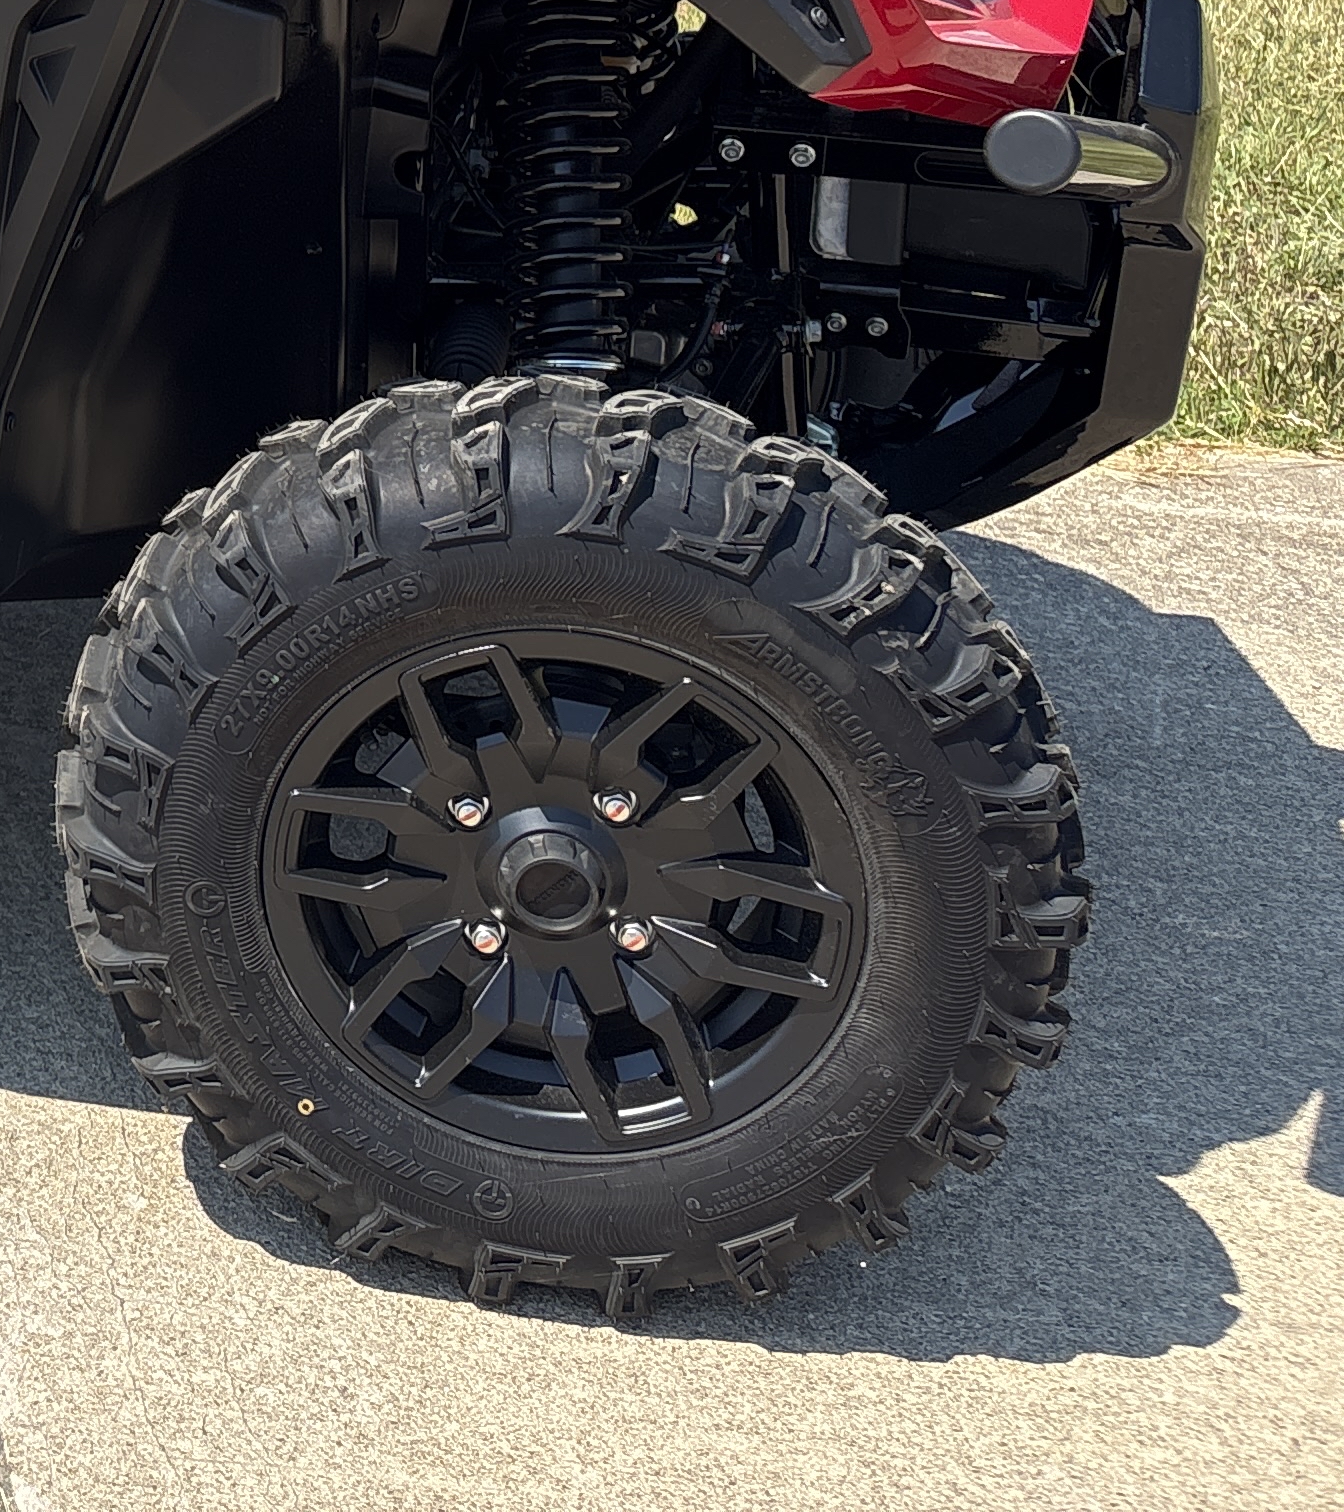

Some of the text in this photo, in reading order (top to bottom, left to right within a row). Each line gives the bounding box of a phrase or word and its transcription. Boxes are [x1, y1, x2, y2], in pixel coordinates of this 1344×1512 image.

[272, 677, 296, 703] FOR
[292, 637, 347, 681] HIGHWAY
[349, 607, 406, 641] SERVICE
[712, 632, 894, 772] ARMSTRONG
[199, 925, 465, 1197] DIRT MASTER
[863, 1096, 889, 1122] PLY
[743, 1109, 840, 1176] MADE IN CHINA
